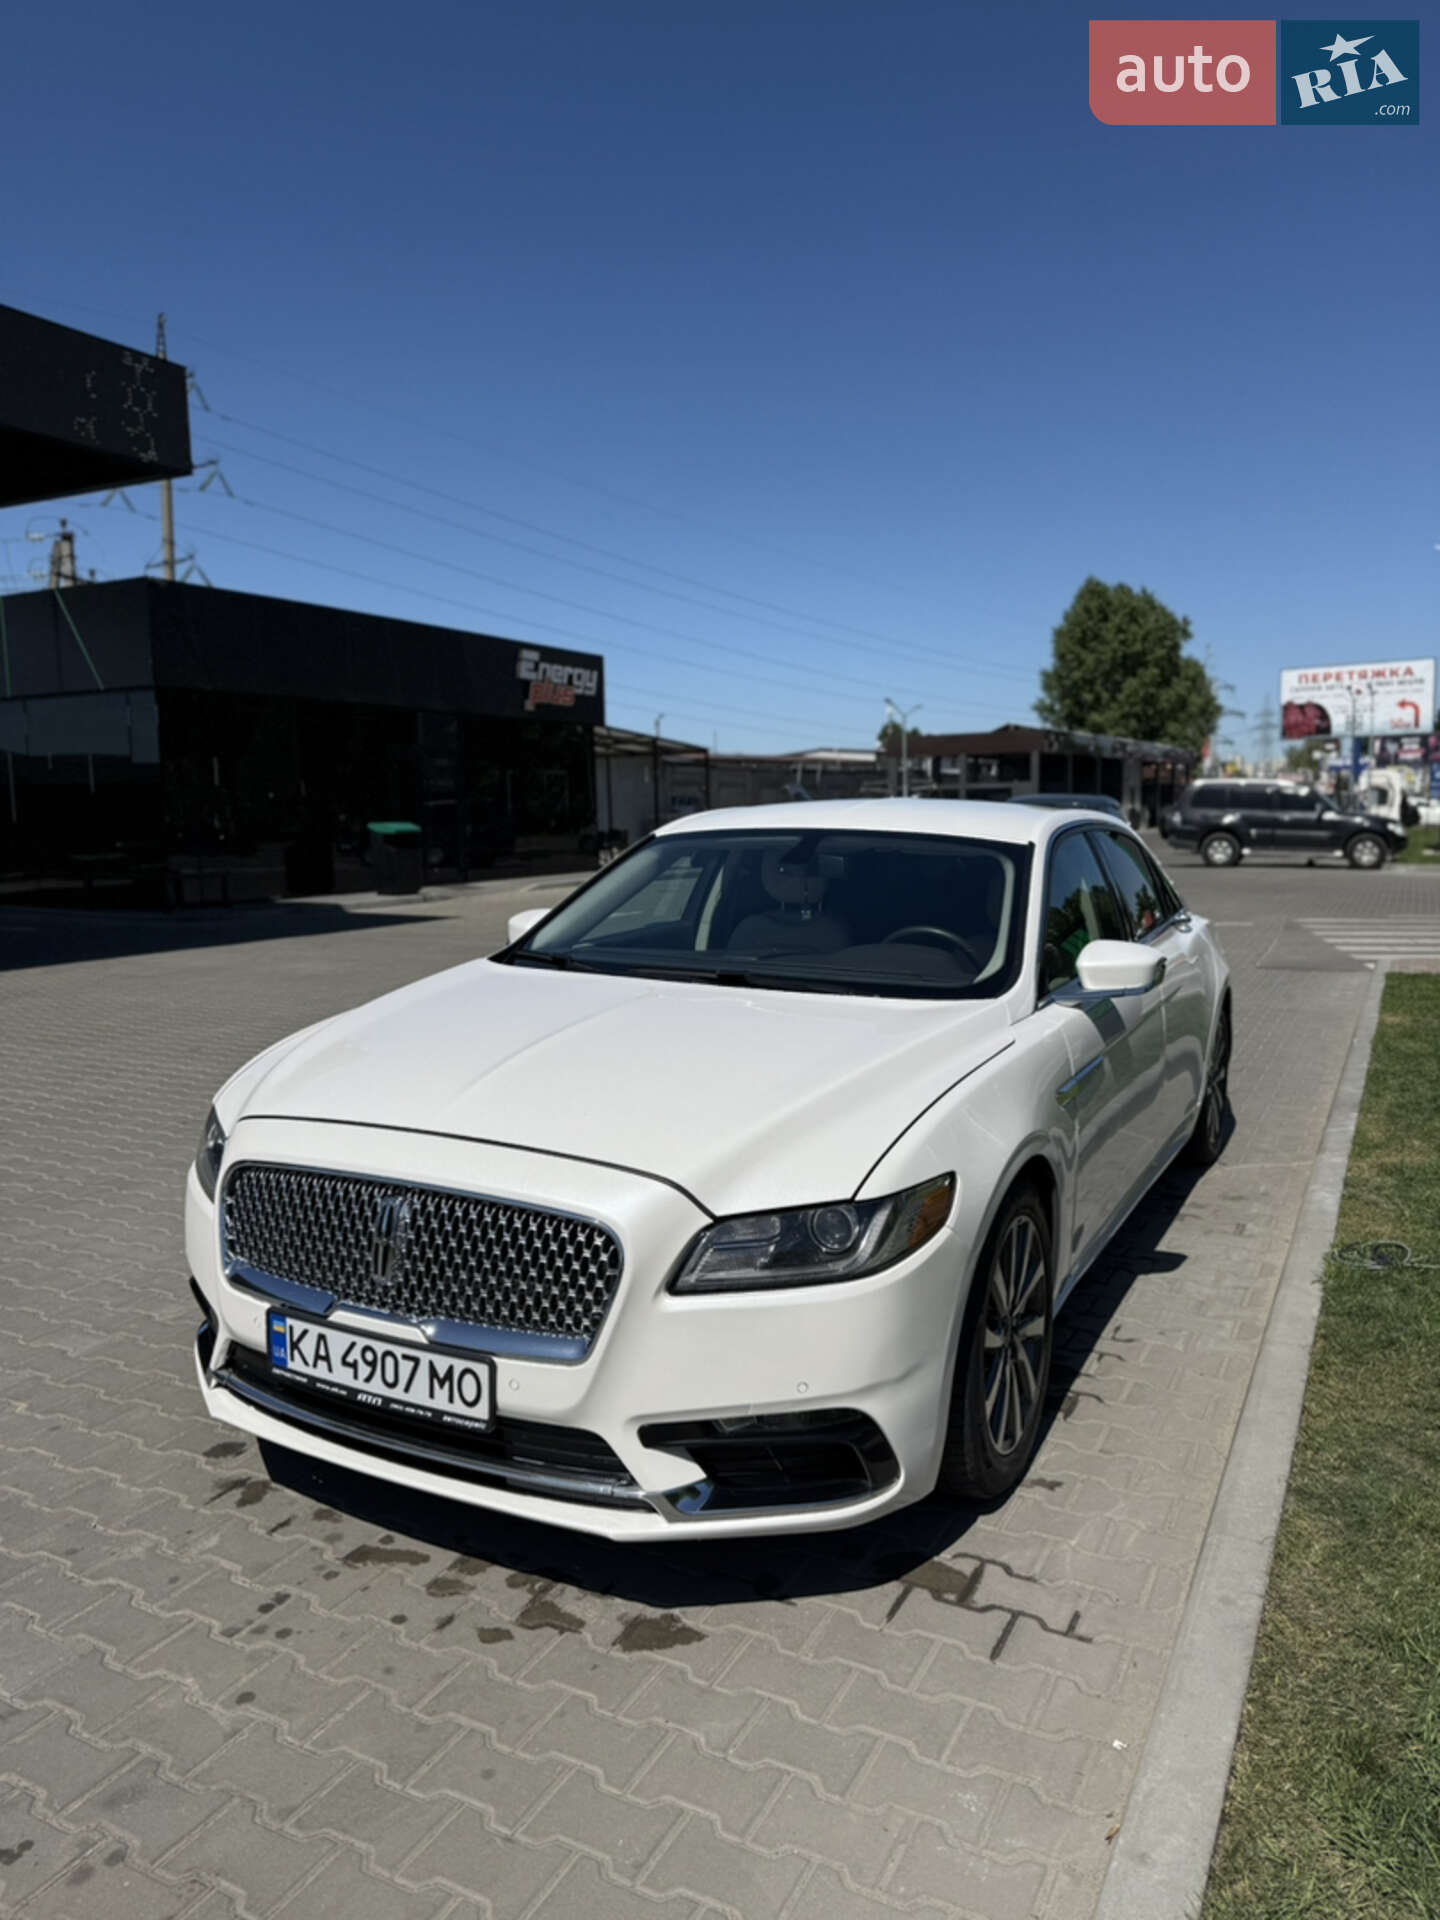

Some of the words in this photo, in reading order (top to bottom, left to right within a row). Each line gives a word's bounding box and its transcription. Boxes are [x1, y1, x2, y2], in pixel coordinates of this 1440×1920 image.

[516, 649, 598, 696] Energy
[1297, 666, 1415, 685] ПЕРЕТЯЖКА
[524, 676, 577, 712] plus
[288, 1324, 334, 1374] KA
[341, 1341, 420, 1394] 4907
[429, 1359, 483, 1409] MO
